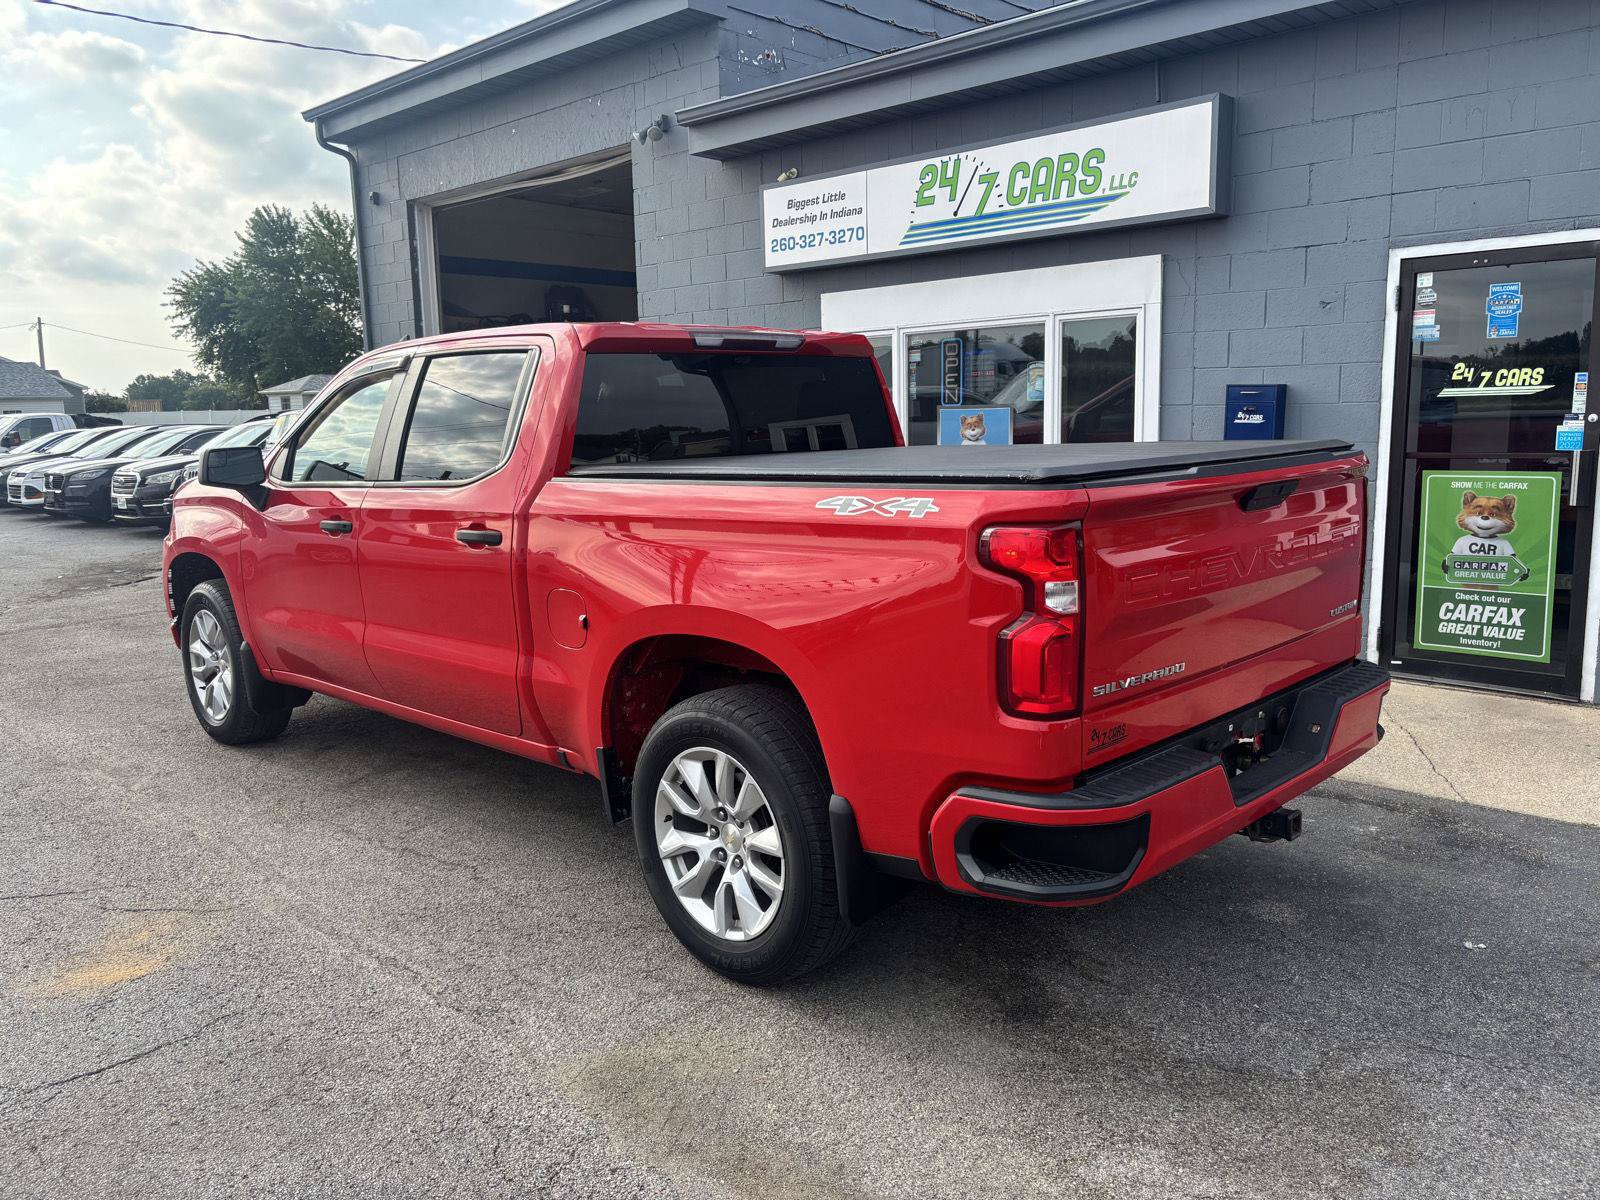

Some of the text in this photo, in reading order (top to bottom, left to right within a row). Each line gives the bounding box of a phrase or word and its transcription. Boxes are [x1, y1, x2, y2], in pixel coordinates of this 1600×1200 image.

[787, 191, 846, 211] Biggest Little
[772, 207, 863, 229] Dealership In Indiana
[771, 226, 865, 253] 260-327-3270
[945, 343, 959, 403] OPEN
[1494, 367, 1545, 386] CARS
[1450, 481, 1472, 489] SHOW
[1498, 482, 1528, 490] CARFAX
[1468, 542, 1498, 556] CAR
[1125, 522, 1360, 604] CHEVROLET
[1454, 561, 1508, 572] CARFAX
[1480, 572, 1507, 580] VALUE
[1455, 592, 1512, 604] Check out our
[1439, 602, 1526, 627] CARFAX
[1438, 621, 1526, 641] GREAT VALUE
[1460, 636, 1502, 648] Inventory!
[1092, 661, 1186, 697] SILVERADO
